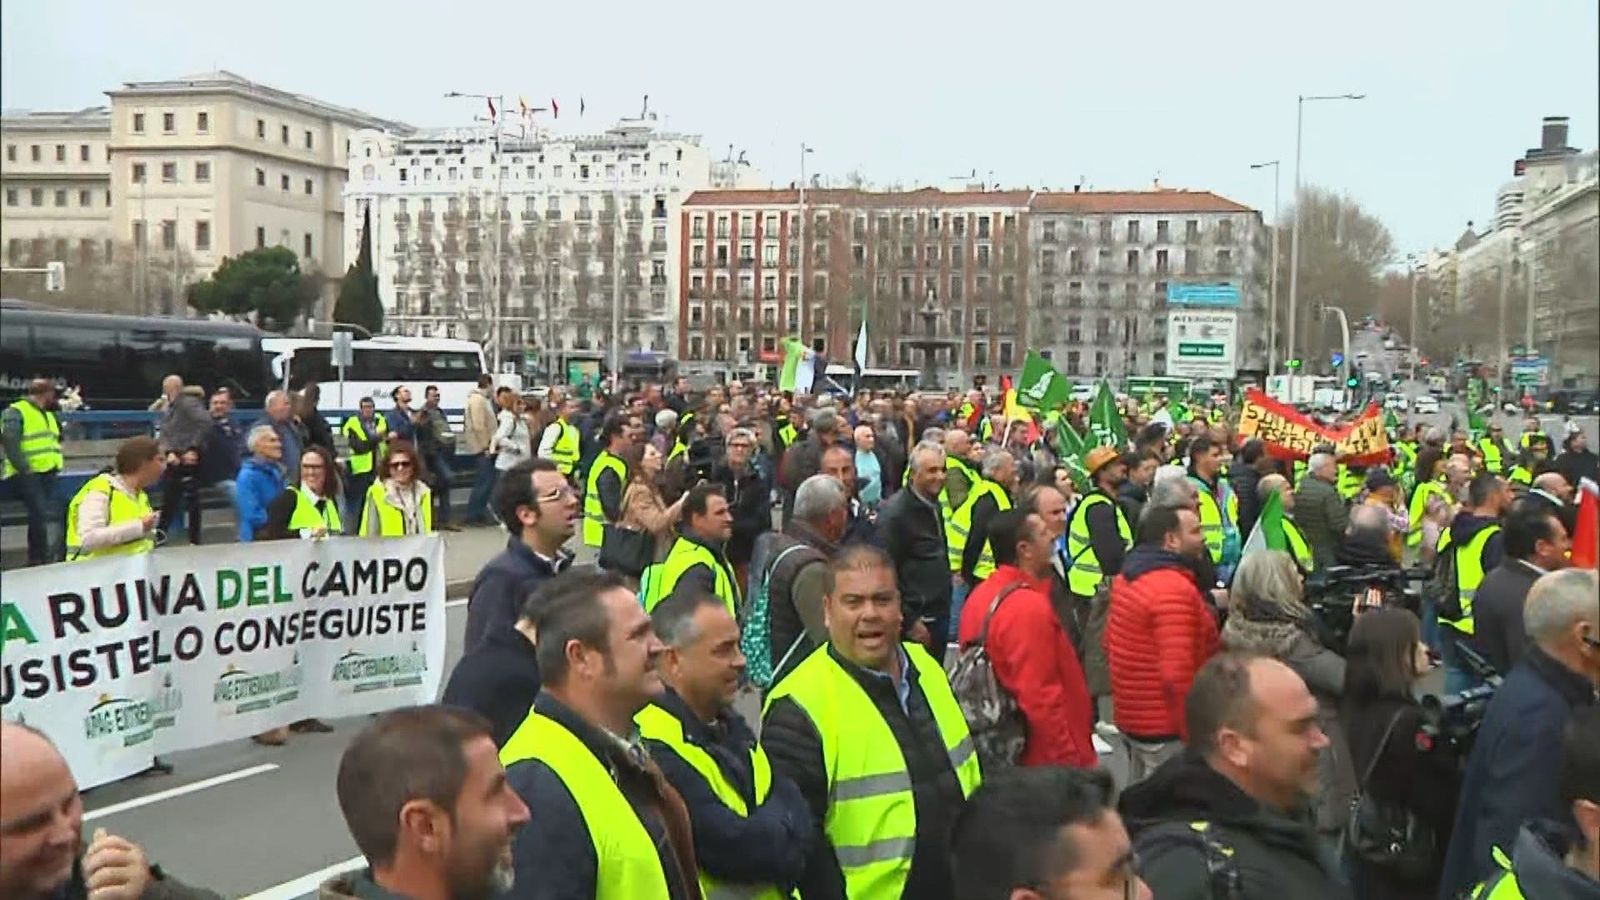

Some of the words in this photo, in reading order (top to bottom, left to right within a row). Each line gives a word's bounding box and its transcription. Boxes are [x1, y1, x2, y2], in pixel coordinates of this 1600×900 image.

[216, 565, 293, 610] DEL
[302, 557, 428, 598] CAMPO
[214, 602, 426, 655] CONSEGUISTE
